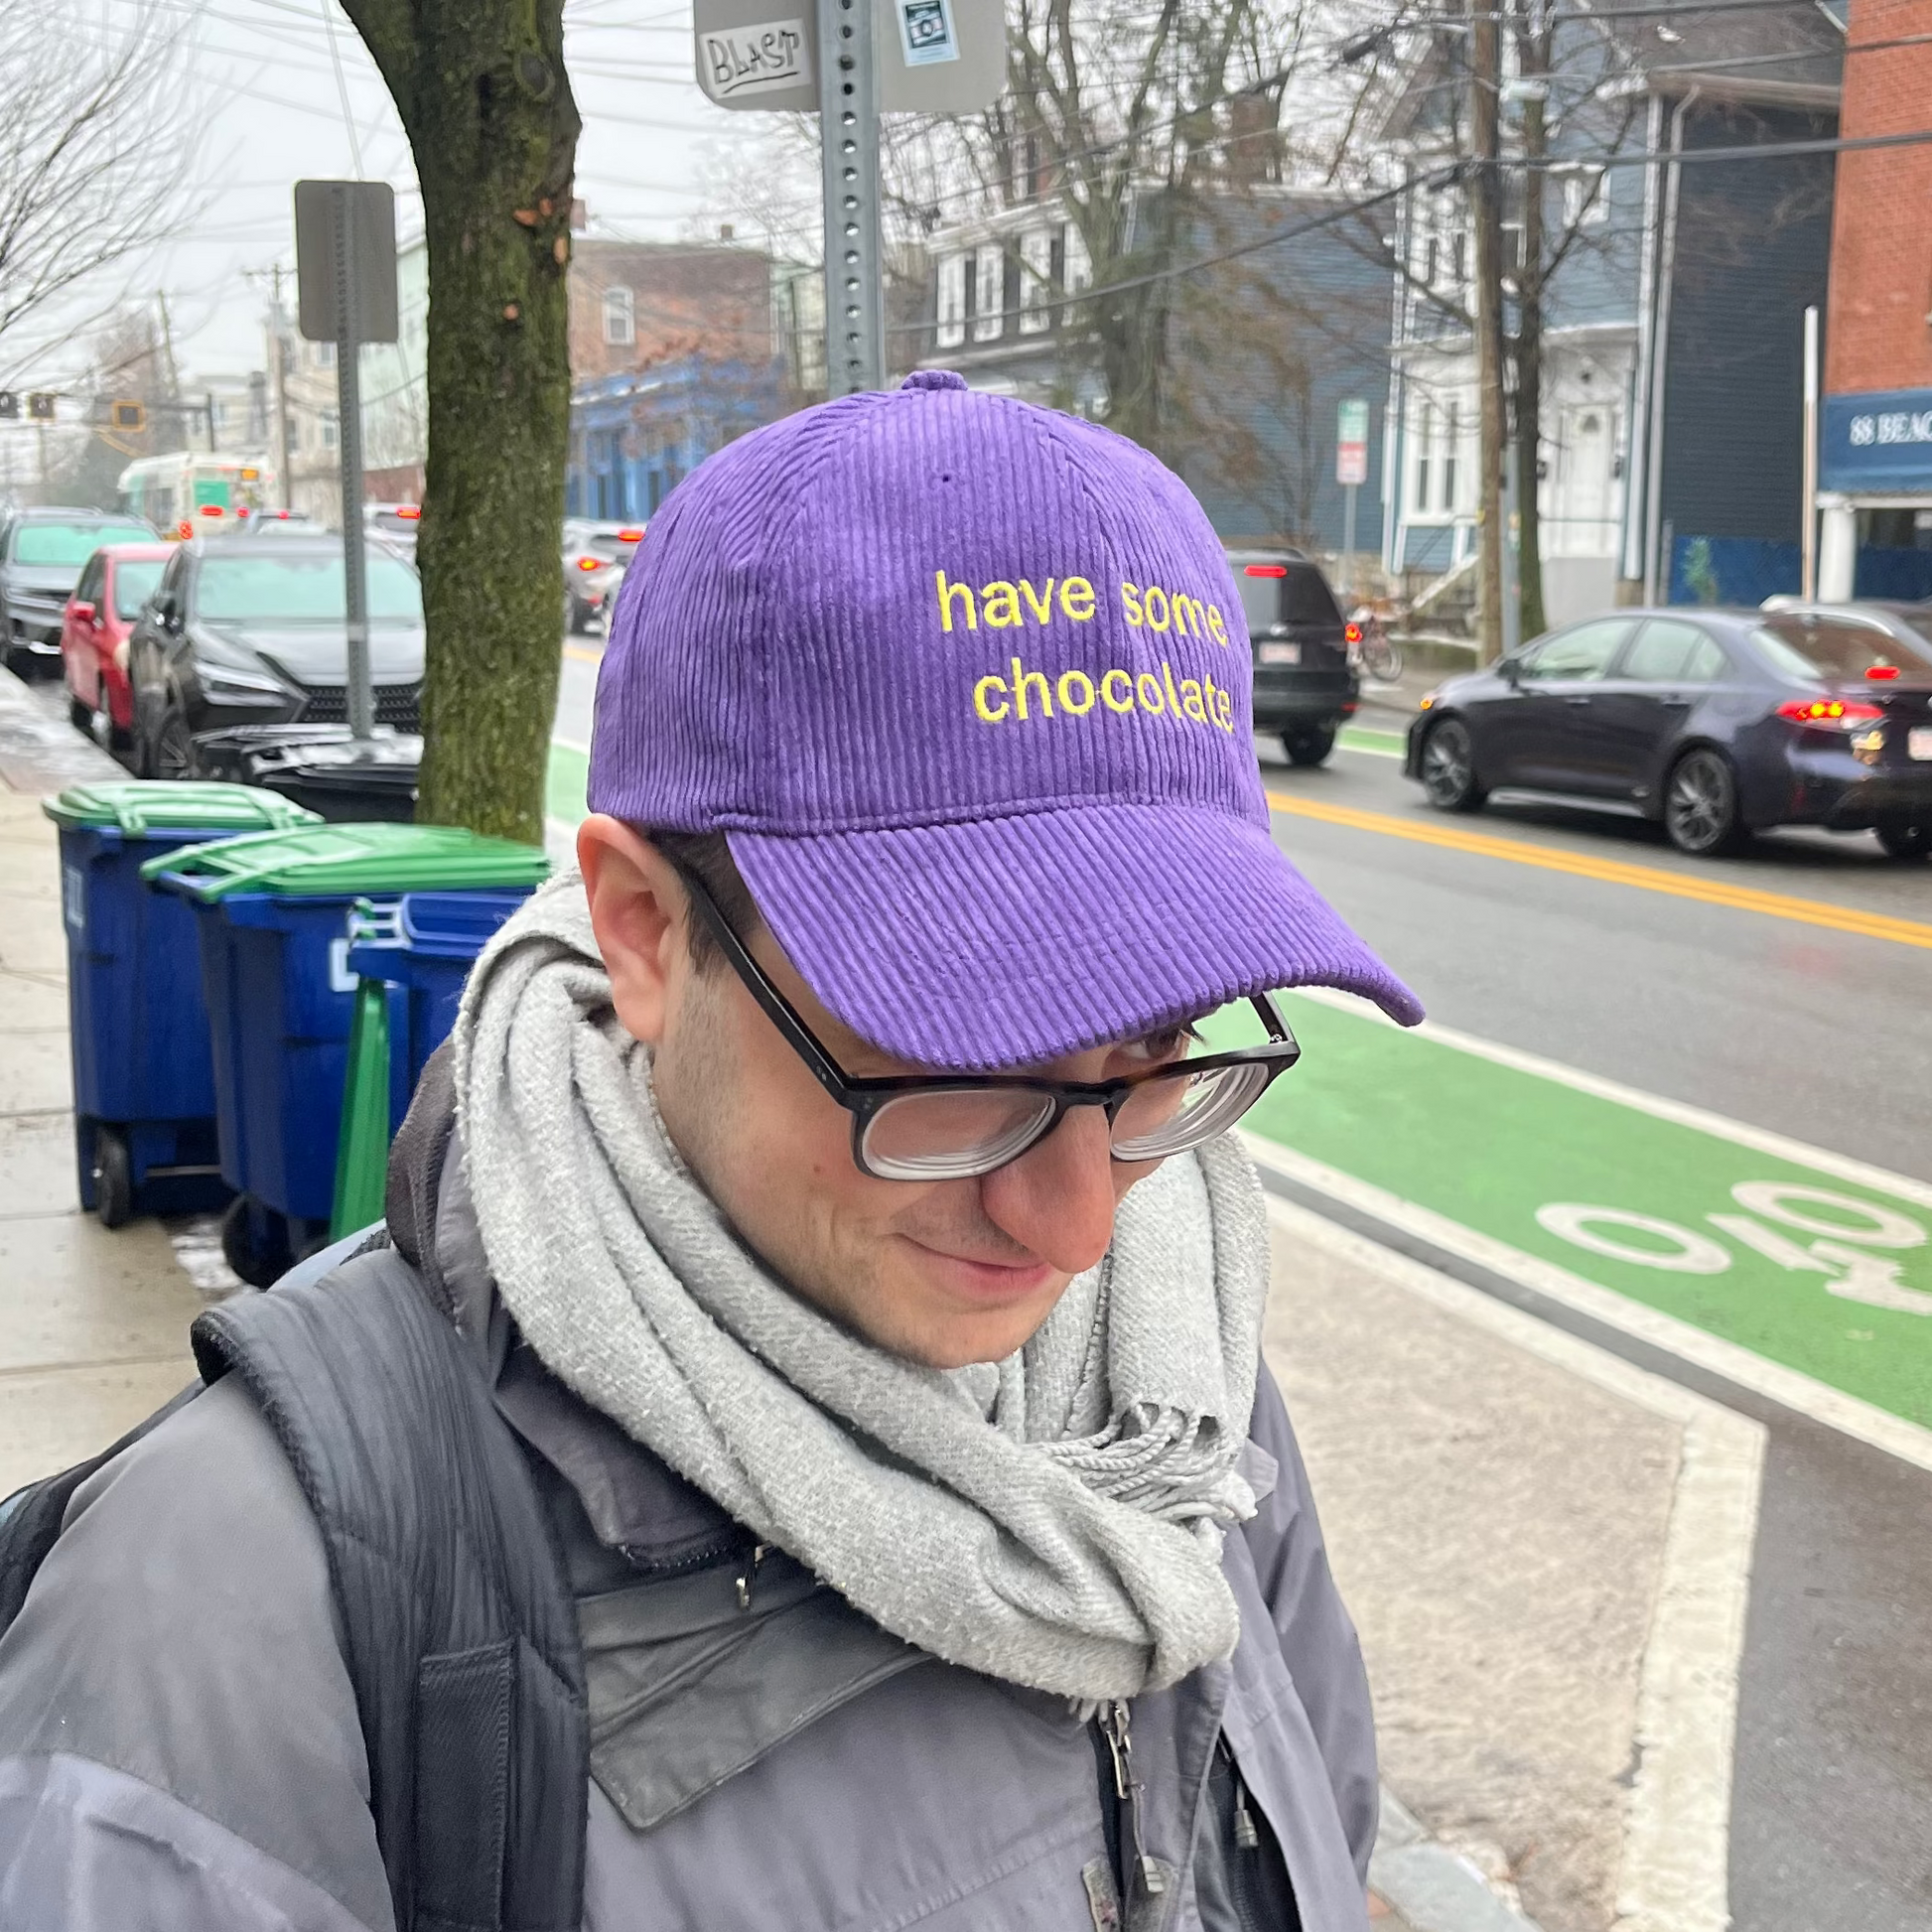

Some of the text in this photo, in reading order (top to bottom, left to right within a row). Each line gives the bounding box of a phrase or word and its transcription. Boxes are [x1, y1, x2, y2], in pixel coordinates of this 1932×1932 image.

[707, 30, 800, 84] BLAST
[1850, 415, 1875, 446] 88
[935, 569, 1228, 647] have some
[973, 656, 1234, 734] chocolate
